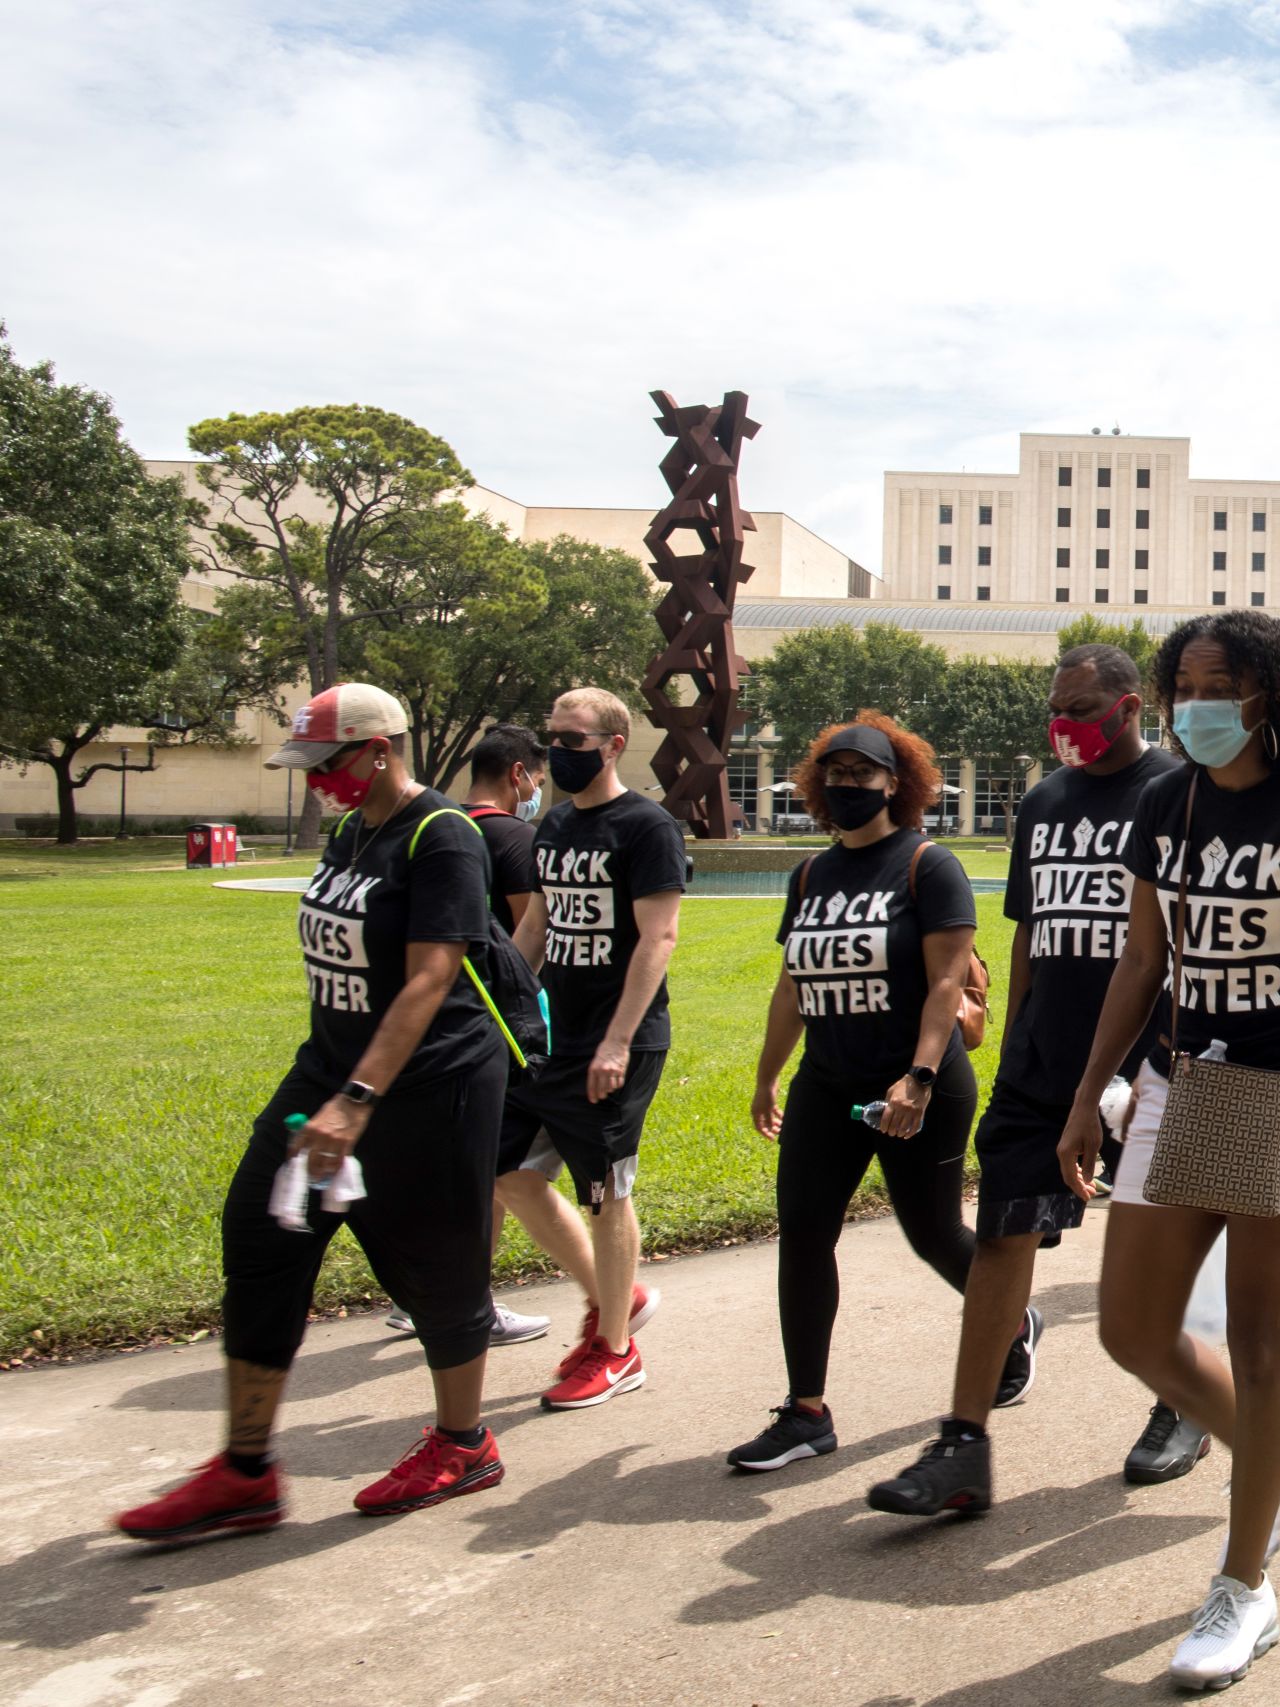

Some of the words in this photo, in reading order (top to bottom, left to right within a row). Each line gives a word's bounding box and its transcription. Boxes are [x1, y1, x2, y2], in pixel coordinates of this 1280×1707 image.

[1031, 869, 1126, 907] LIVES
[548, 893, 602, 925] IVES
[1166, 899, 1268, 951] IVES
[299, 911, 353, 961] IVES
[545, 928, 613, 966] ATTER
[785, 933, 873, 970] LIVES
[305, 960, 372, 1013] TTER
[798, 979, 892, 1016] ATTER
